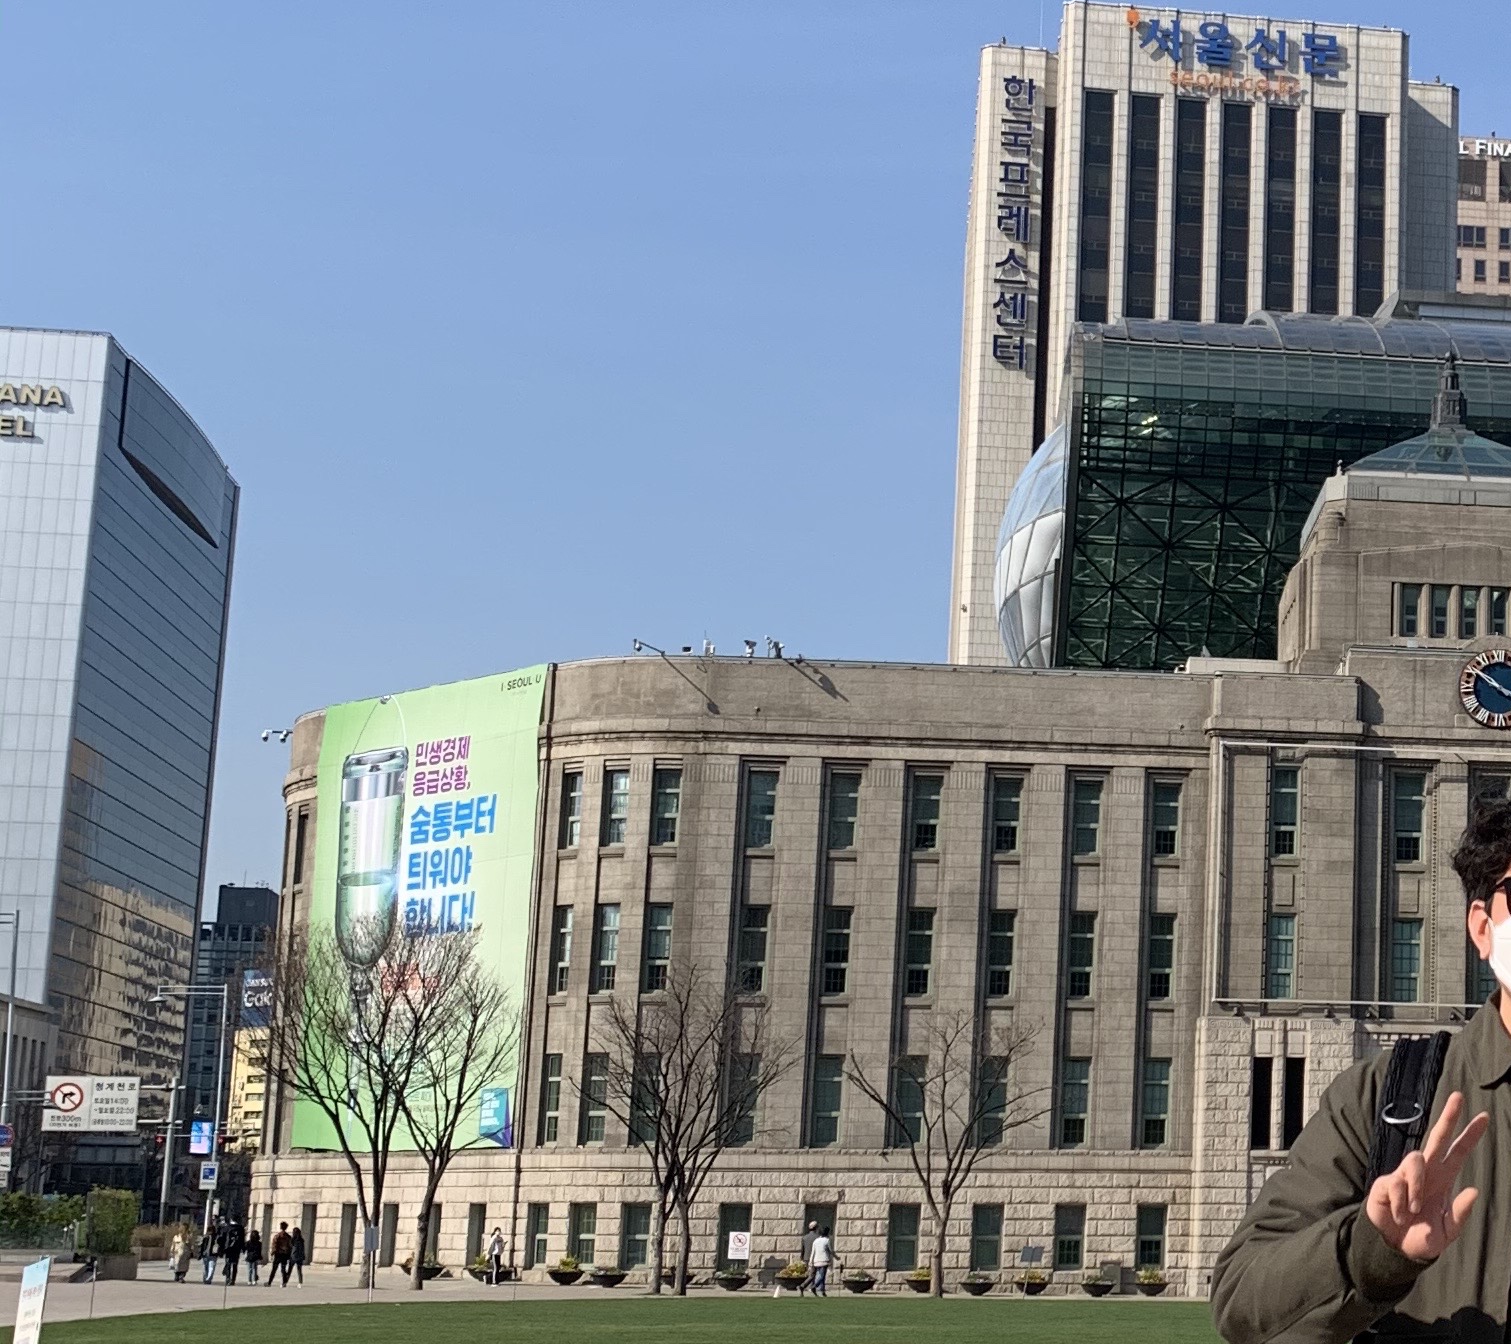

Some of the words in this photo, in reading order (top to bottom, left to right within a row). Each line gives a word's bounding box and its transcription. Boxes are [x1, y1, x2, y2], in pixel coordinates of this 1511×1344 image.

[1139, 18, 1340, 79] 서울신문
[1169, 69, 1301, 97] seoul.co.kr
[992, 75, 1036, 371] 한국프레스센터
[507, 676, 533, 691] SEOUL
[415, 735, 471, 768] 민생경제
[412, 764, 471, 797] 응급상황,
[409, 793, 498, 846] 숨통부터
[406, 844, 473, 891] 틔워야
[95, 1082, 137, 1092] 청계천로
